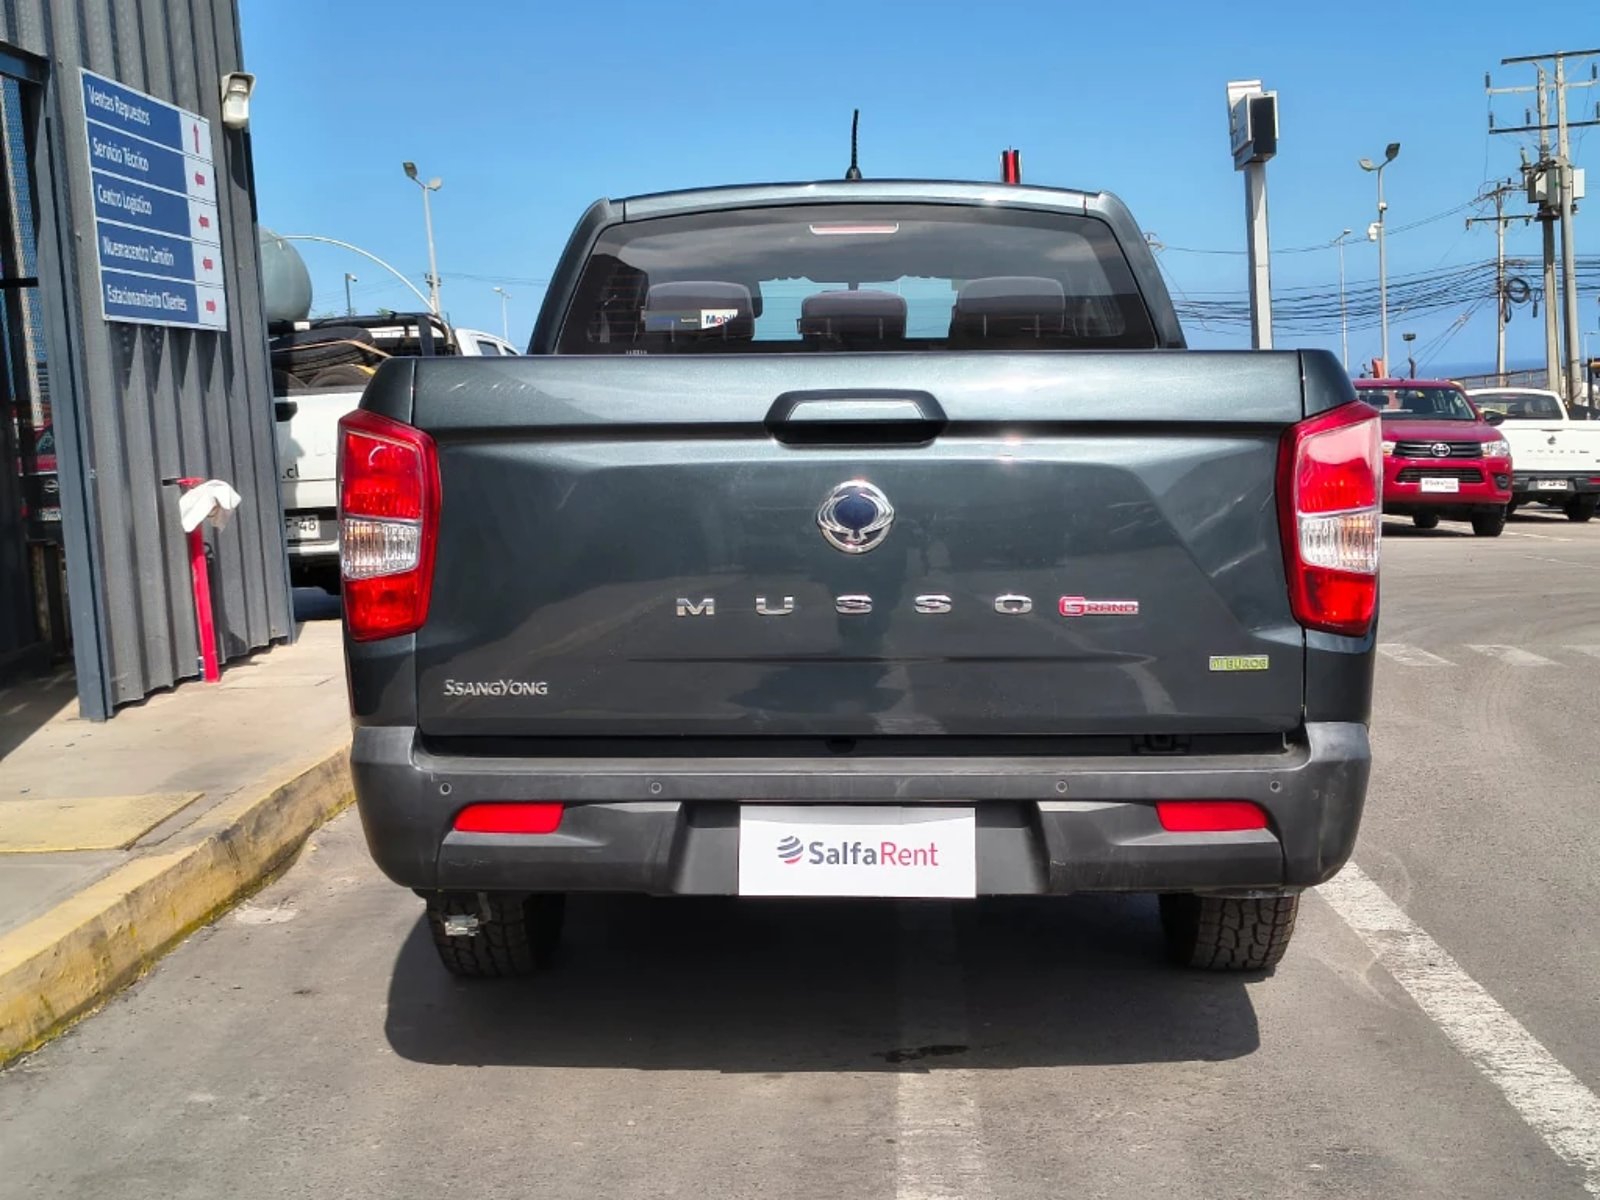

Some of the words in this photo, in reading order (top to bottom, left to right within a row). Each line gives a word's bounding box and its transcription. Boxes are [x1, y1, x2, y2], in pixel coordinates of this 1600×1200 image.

[87, 84, 114, 111] Ventas
[114, 95, 150, 126] Repuestos
[93, 137, 122, 163] Servicio
[98, 184, 121, 207] Centro
[107, 284, 161, 309] Estacionamiento
[162, 292, 187, 311] Clientes
[676, 594, 1033, 616] MUSSO
[808, 841, 939, 867] SalfaRent
